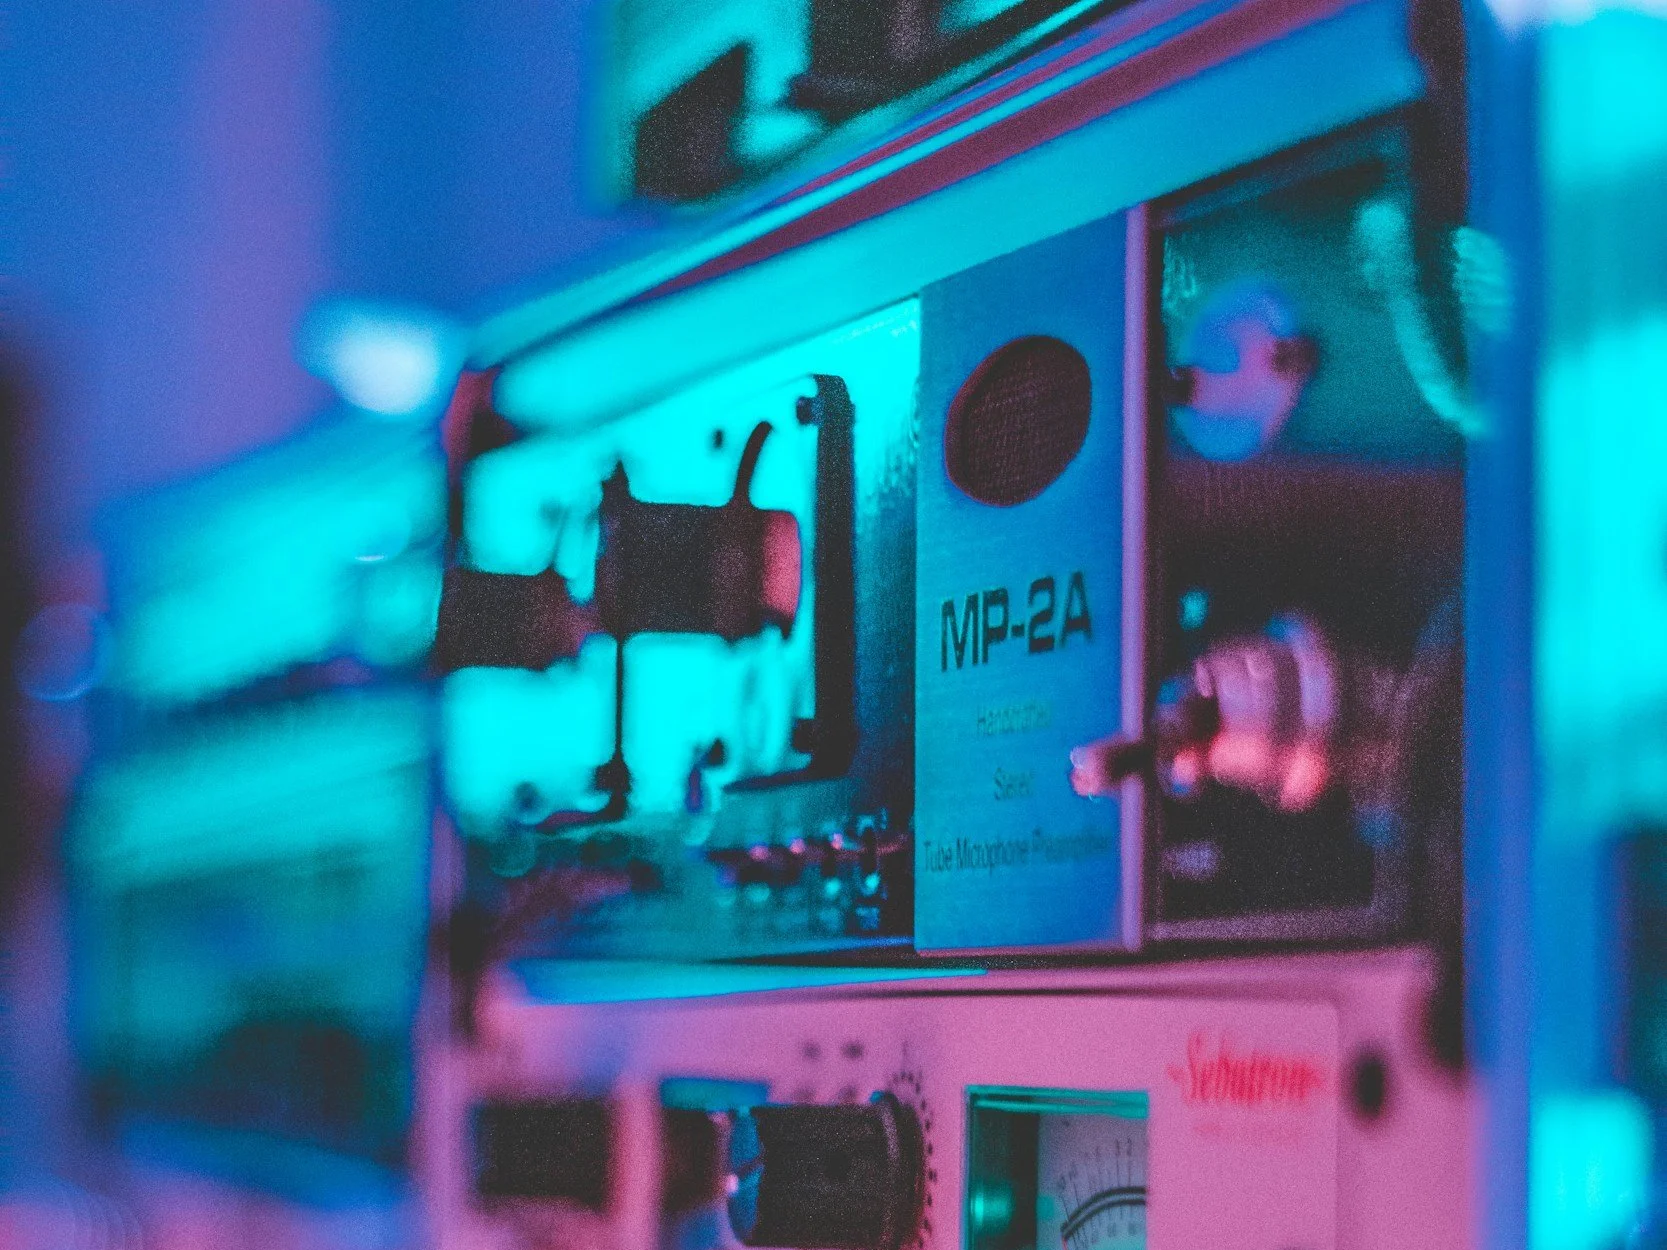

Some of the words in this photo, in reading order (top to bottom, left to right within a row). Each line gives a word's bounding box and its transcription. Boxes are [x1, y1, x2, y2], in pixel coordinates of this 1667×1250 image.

[941, 571, 1093, 673] MP-2A
[923, 836, 954, 872] Tube
[956, 834, 1029, 877] Microphone
